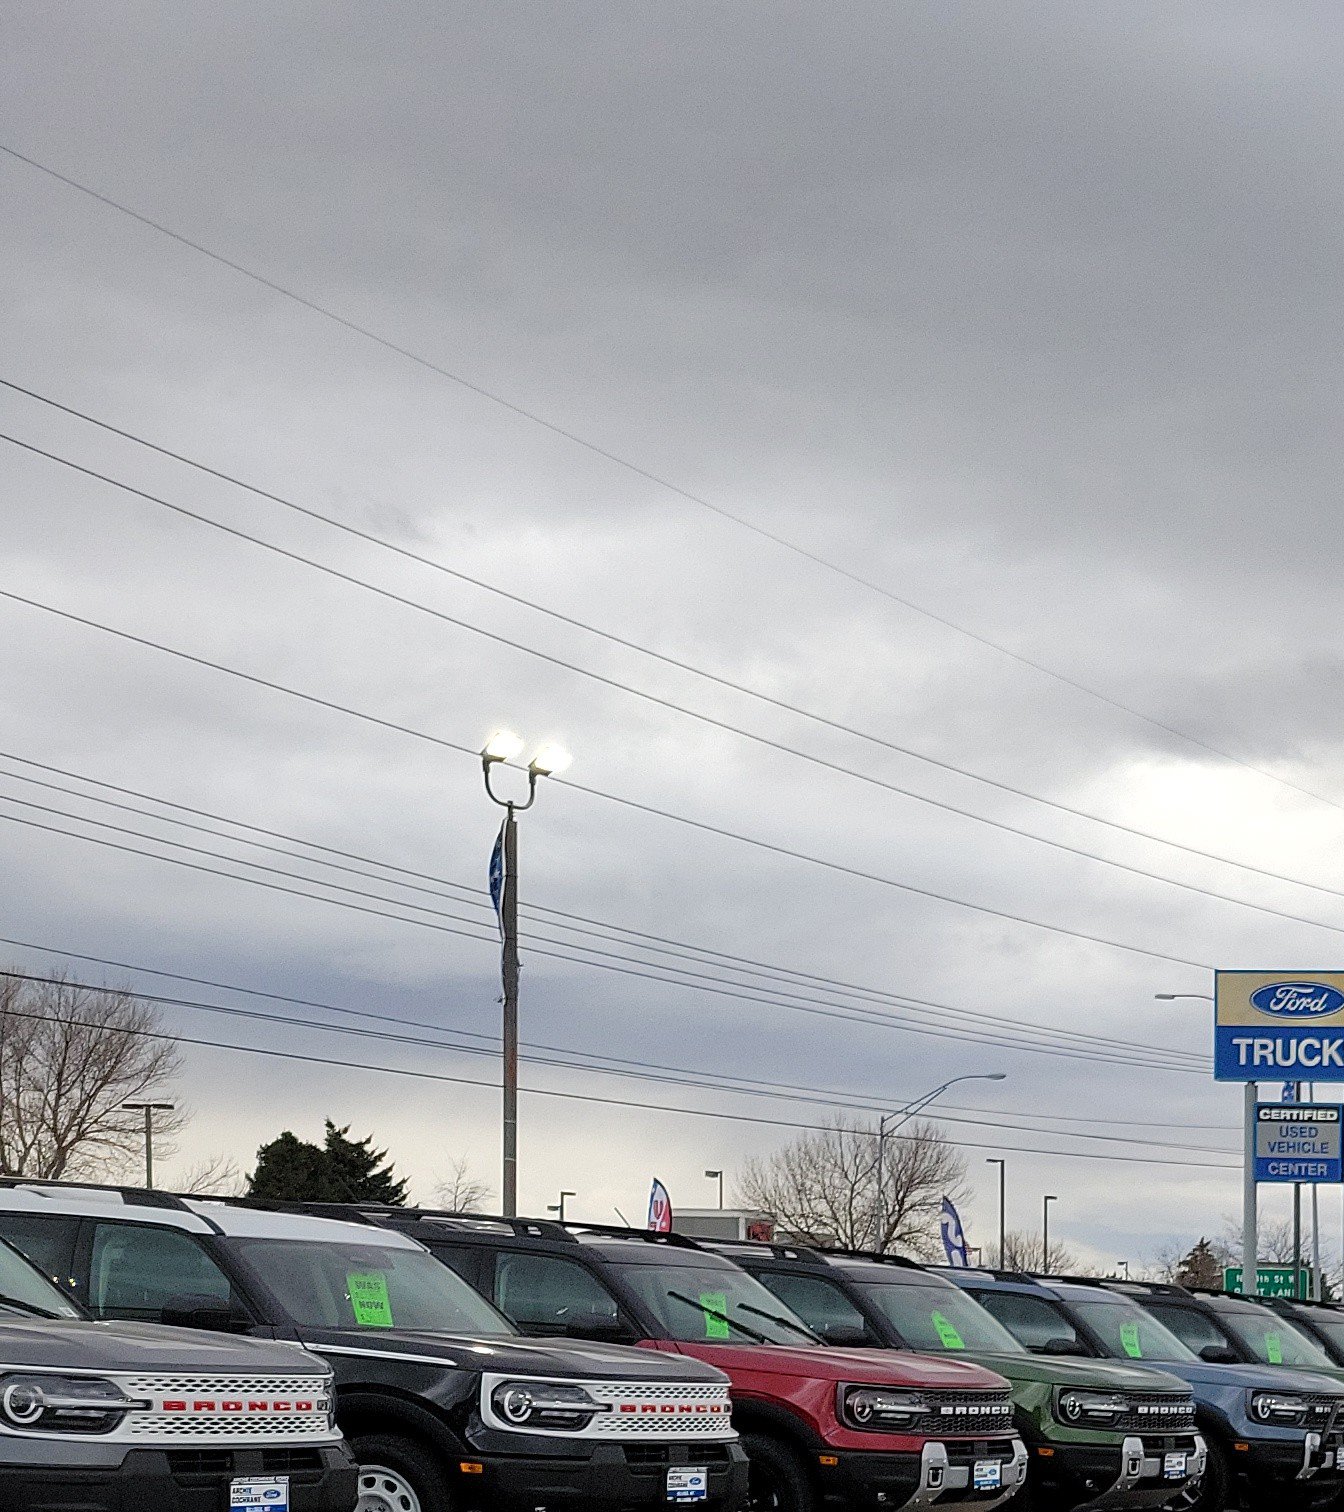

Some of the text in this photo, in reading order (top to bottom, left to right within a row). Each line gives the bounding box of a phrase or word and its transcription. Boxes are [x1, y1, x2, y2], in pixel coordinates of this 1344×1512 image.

[1269, 987, 1329, 1012] Ford
[1259, 1108, 1338, 1121] CERTIFIED
[1279, 1126, 1319, 1139] USED
[1267, 1141, 1330, 1154] VEHICLE
[1267, 1162, 1329, 1176] CENTER
[162, 1400, 313, 1411] BRONCO
[619, 1404, 721, 1413] BRONCO
[940, 1406, 1009, 1415] BRONCO
[1137, 1406, 1193, 1414] BRONCO
